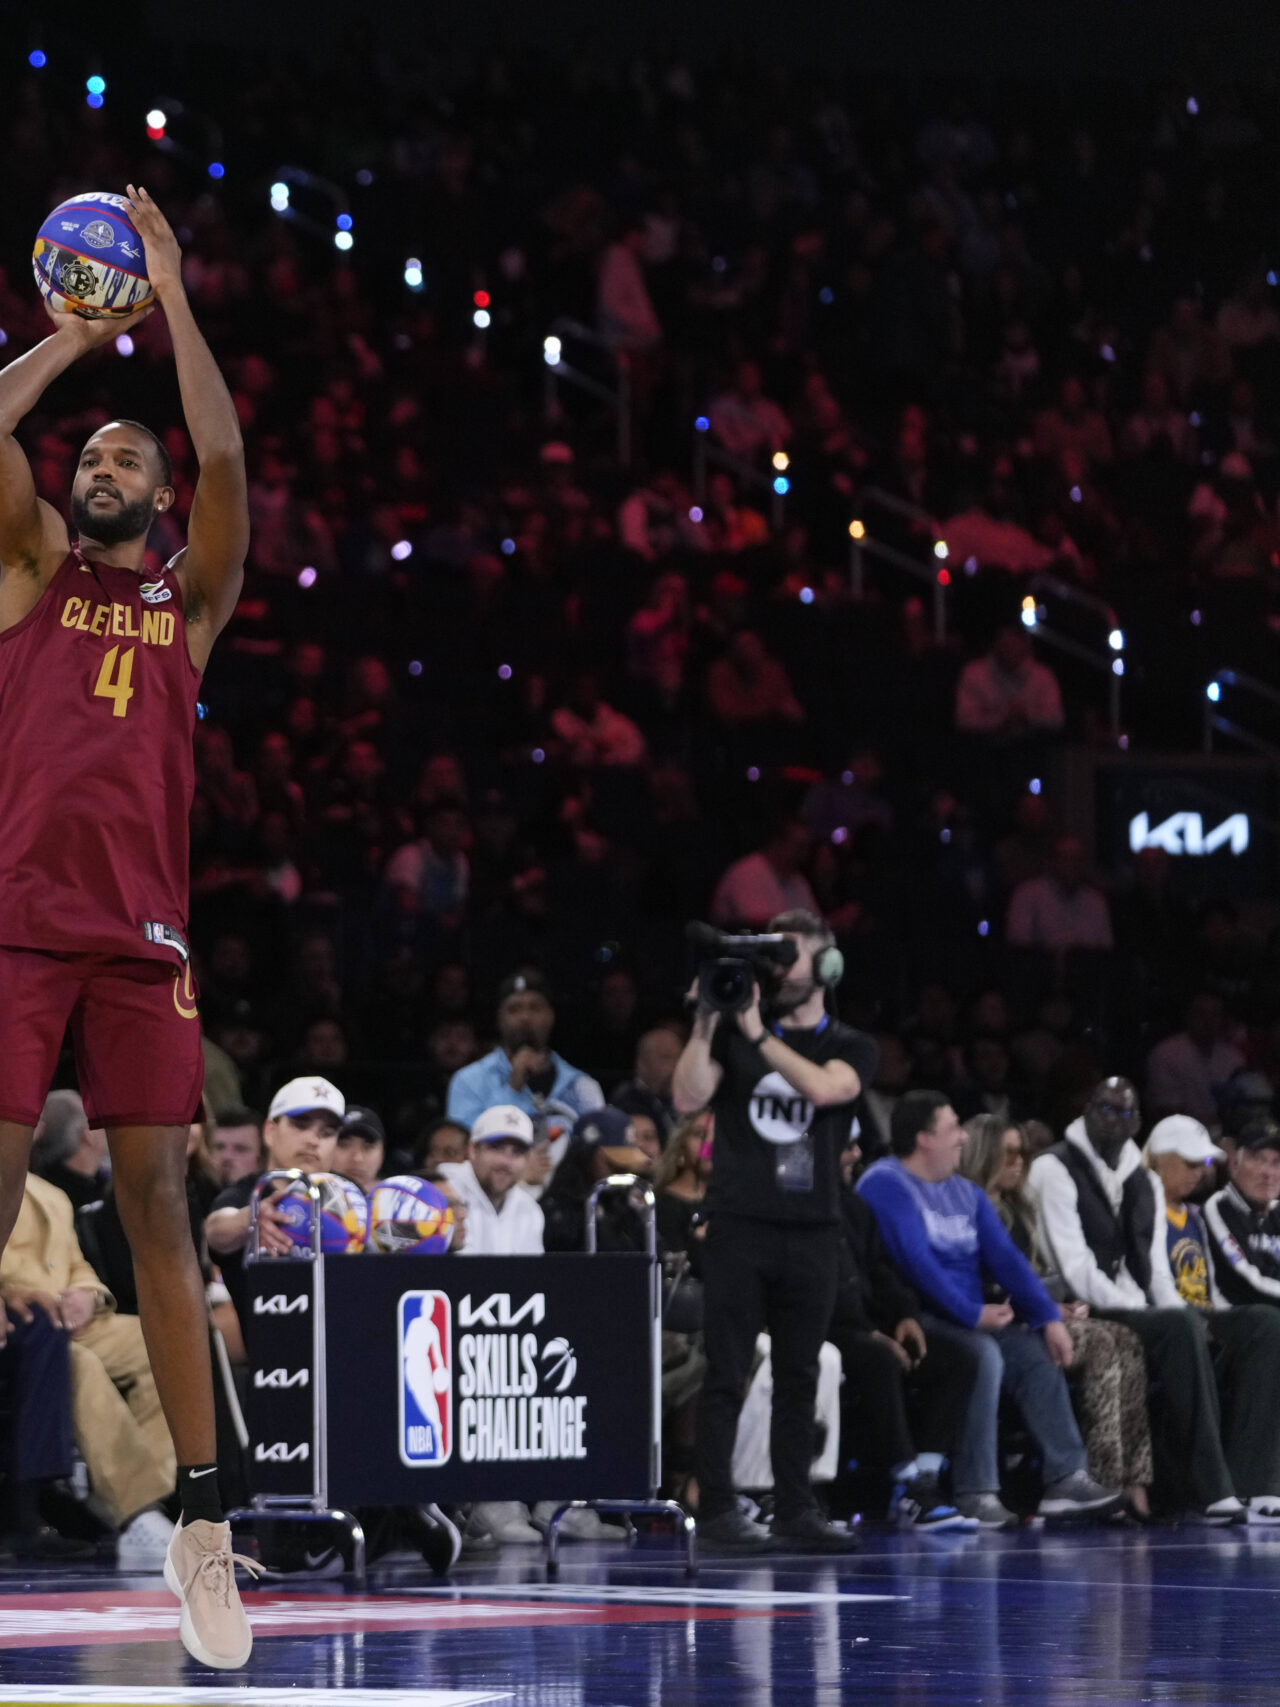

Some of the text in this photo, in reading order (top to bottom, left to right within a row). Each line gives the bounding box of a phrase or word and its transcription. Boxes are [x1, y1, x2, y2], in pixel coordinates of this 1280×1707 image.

[61, 597, 175, 646] CLEELND
[94, 644, 135, 717] 4
[1129, 811, 1249, 856] KIA
[753, 1094, 812, 1122] TNT
[254, 1294, 308, 1314] KIA
[459, 1292, 546, 1327] KIA
[255, 1368, 309, 1388] KIA
[459, 1333, 538, 1397] SKILLS
[407, 1425, 433, 1455] NBA
[460, 1396, 587, 1462] CHALLENGE
[255, 1442, 310, 1461] KIA
